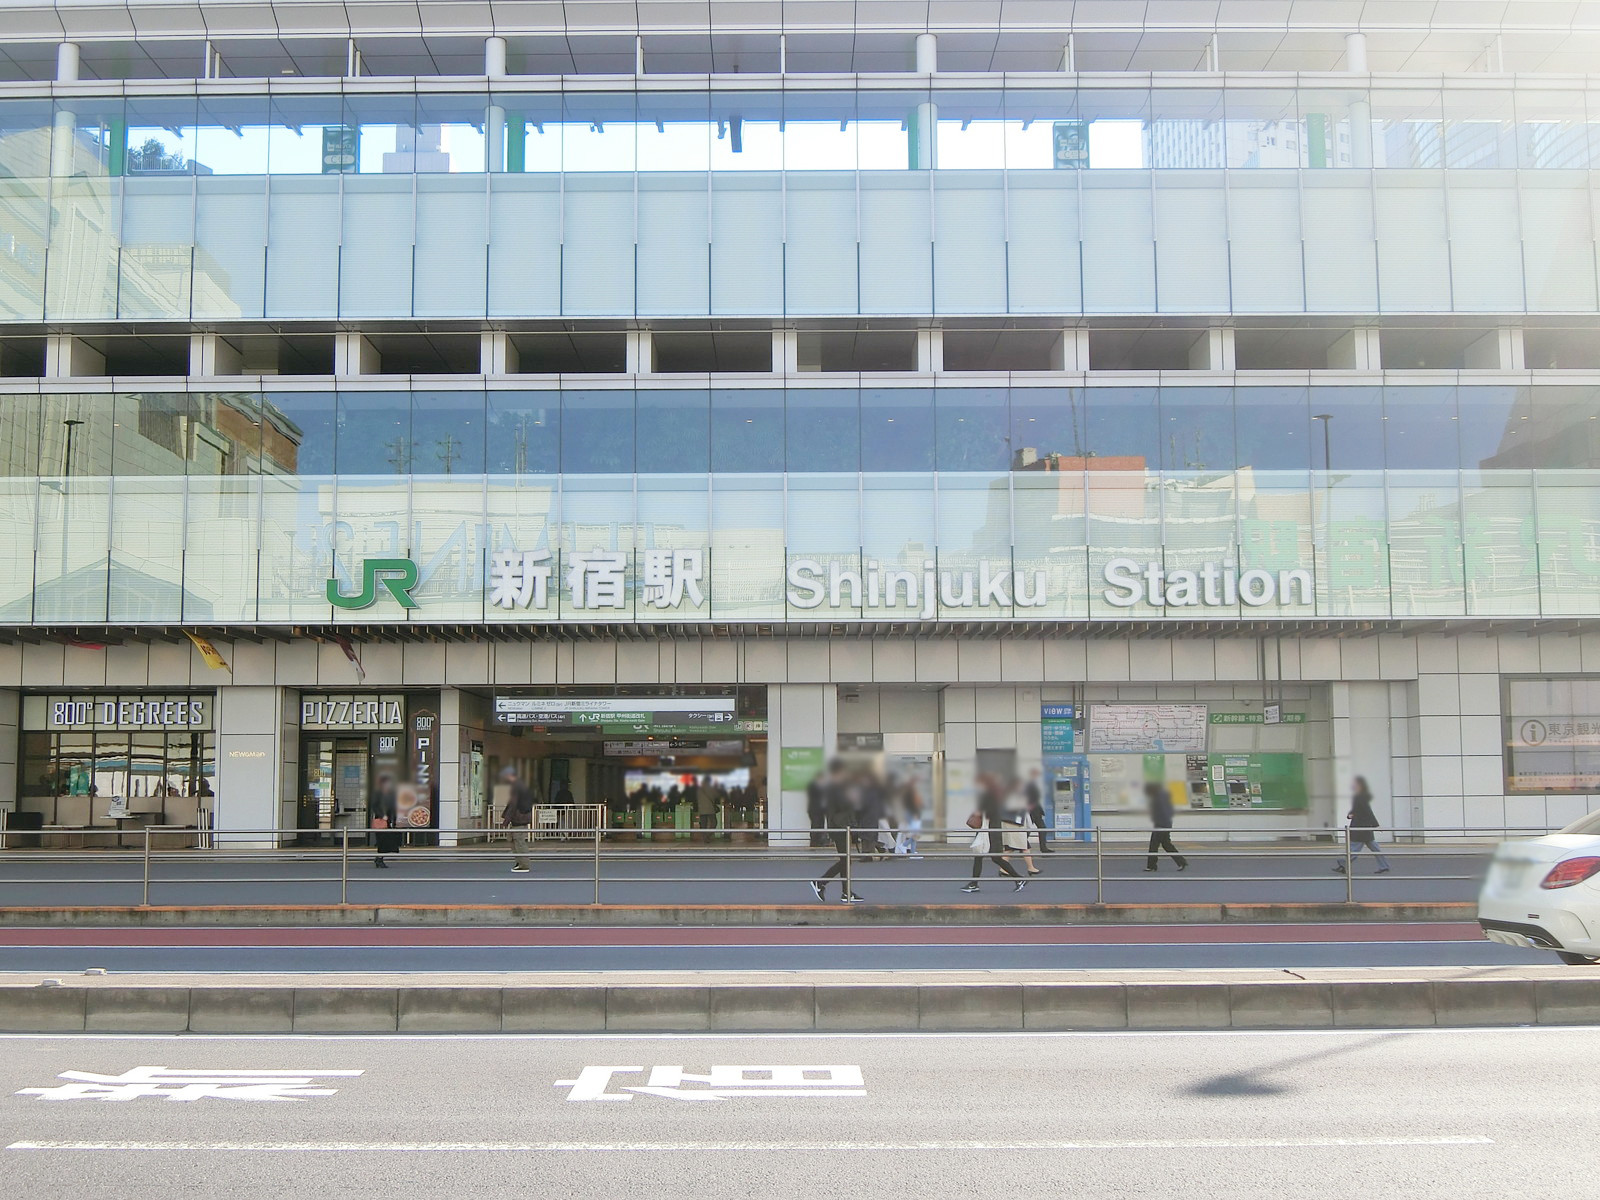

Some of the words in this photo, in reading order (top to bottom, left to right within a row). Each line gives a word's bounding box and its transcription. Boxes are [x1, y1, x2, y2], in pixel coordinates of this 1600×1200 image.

[326, 558, 420, 609] JR
[490, 547, 705, 609] 新宿駅
[786, 558, 1048, 620] Shinjuku
[1103, 557, 1313, 608] Station
[103, 702, 203, 725] DEGREES
[302, 701, 402, 725] PIZZERIA
